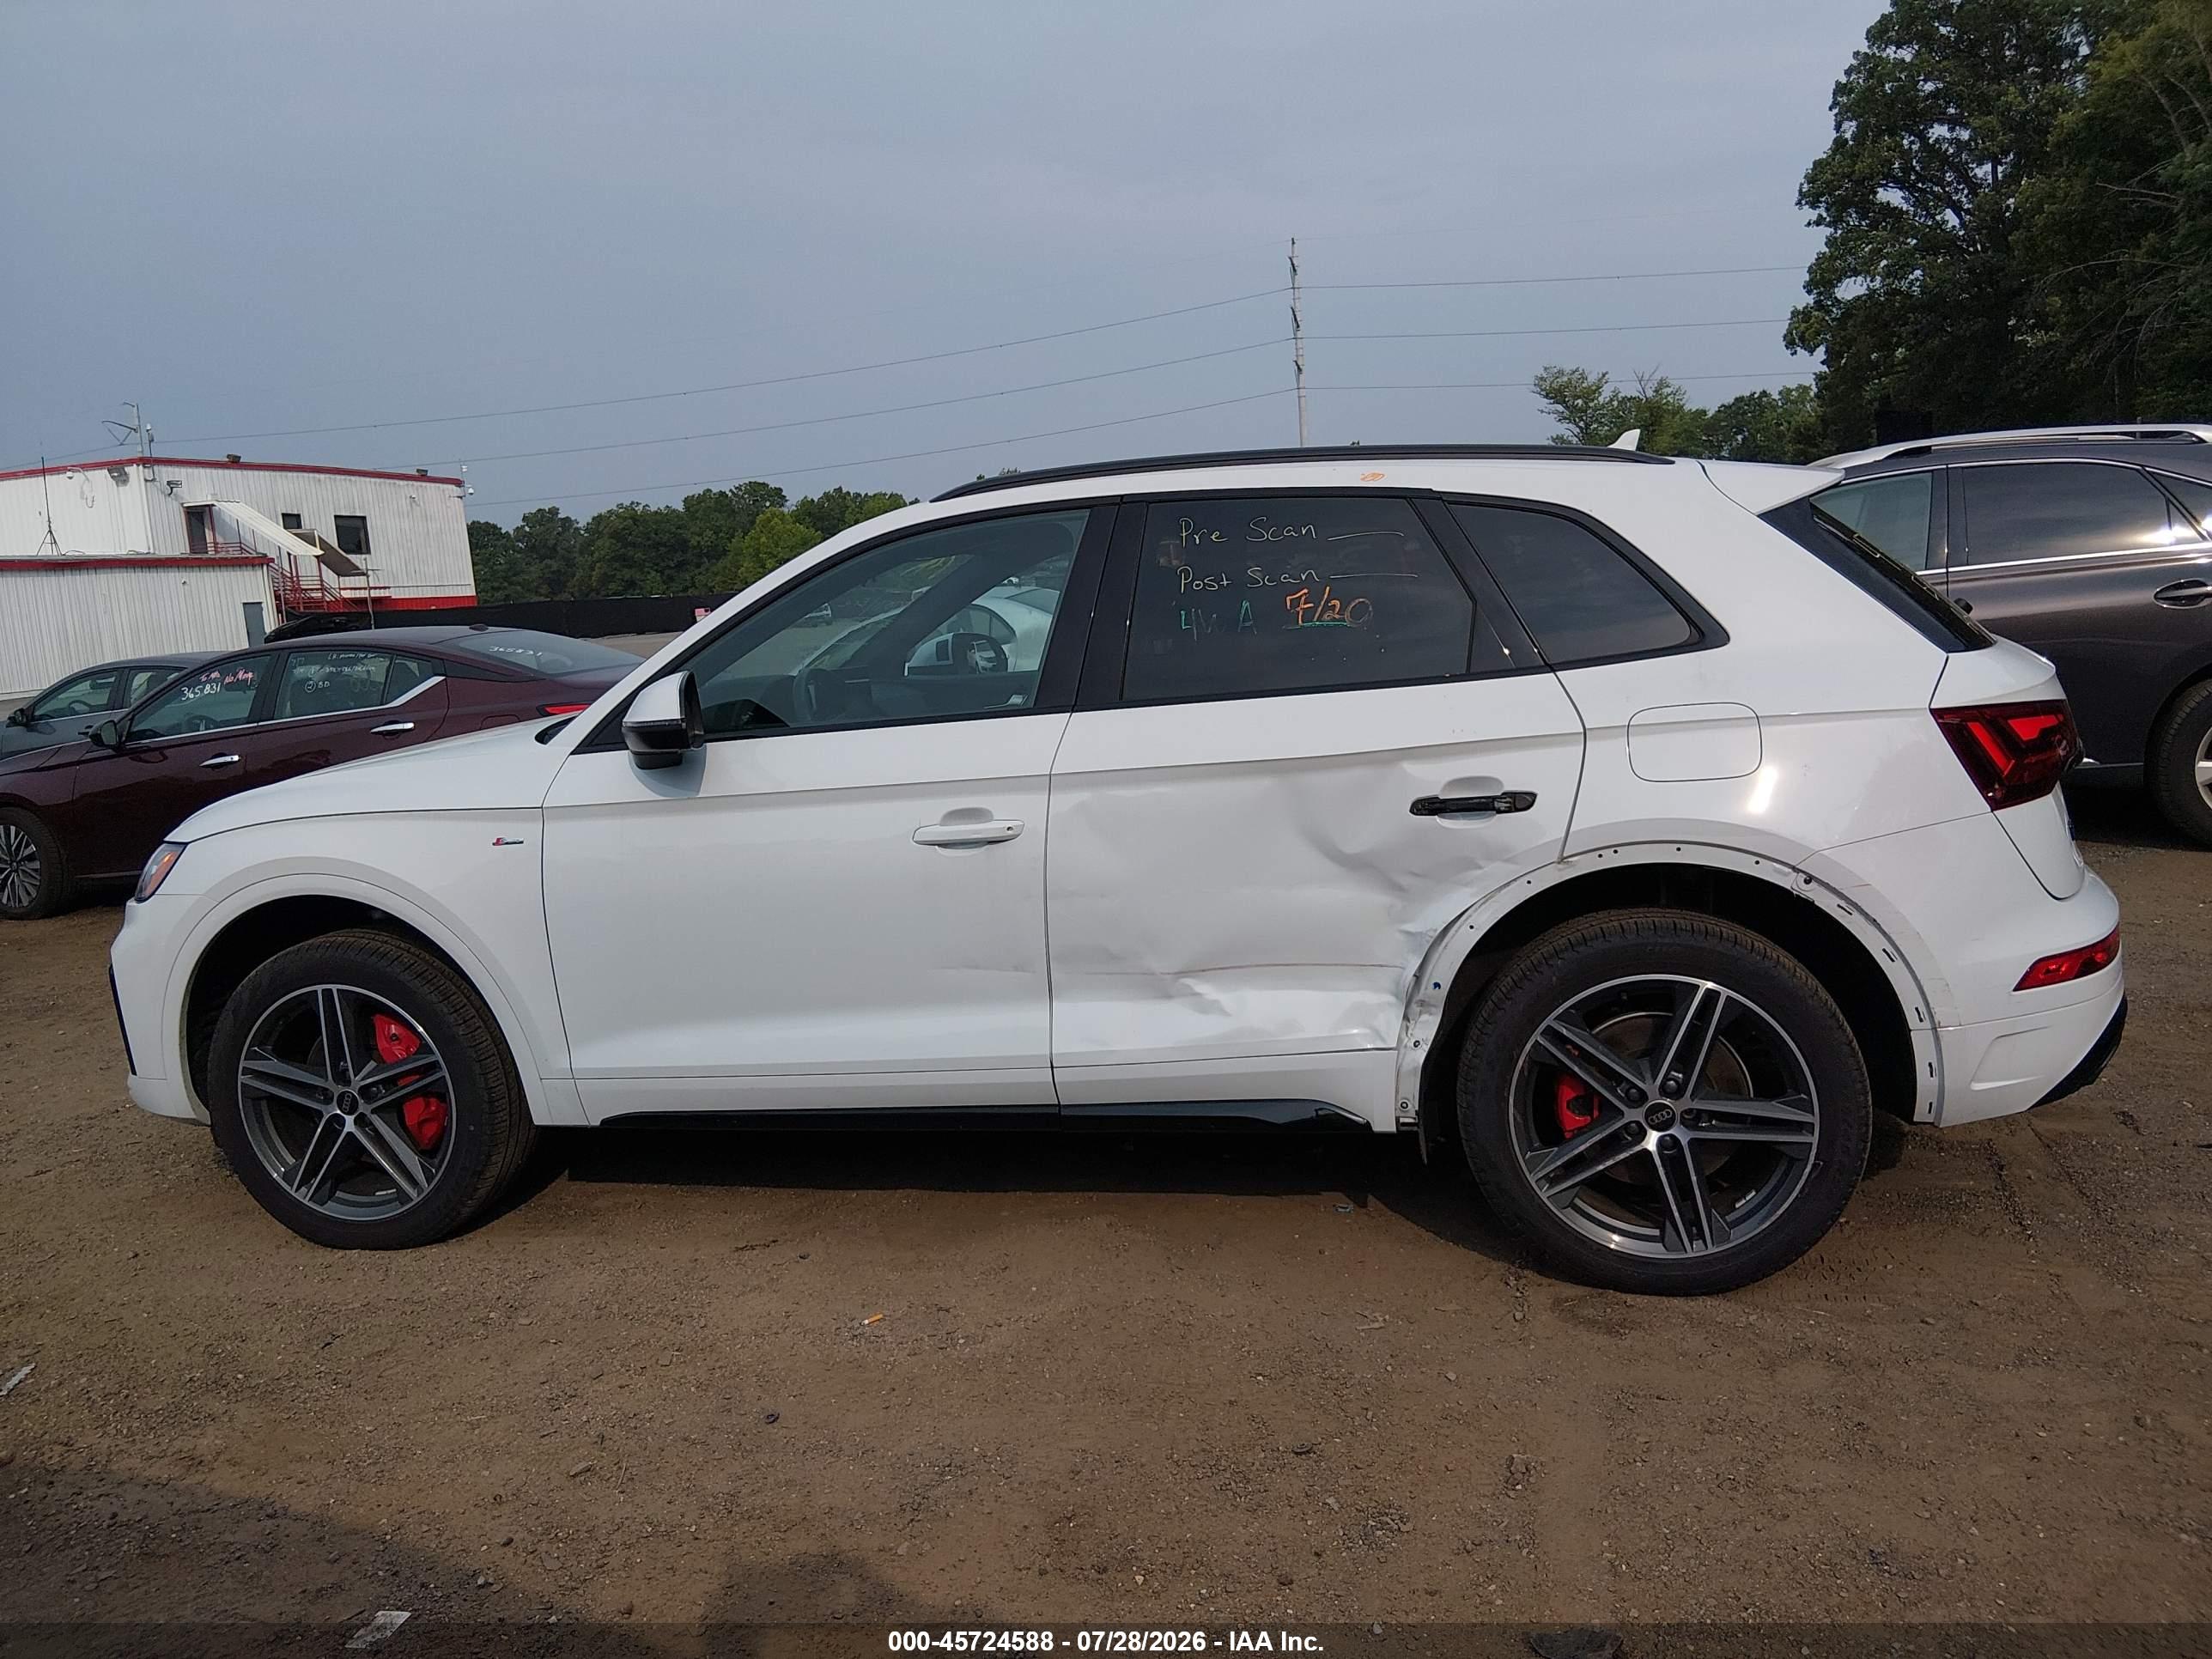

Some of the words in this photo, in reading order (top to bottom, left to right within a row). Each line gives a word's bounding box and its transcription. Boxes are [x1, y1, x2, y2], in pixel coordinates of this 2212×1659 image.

[1179, 517, 1229, 550] Pre
[1245, 516, 1318, 542] Scan
[1176, 566, 1233, 594] Post
[1245, 567, 1321, 589] Scan
[1285, 586, 1374, 627] 7/20
[180, 682, 222, 701] 365831
